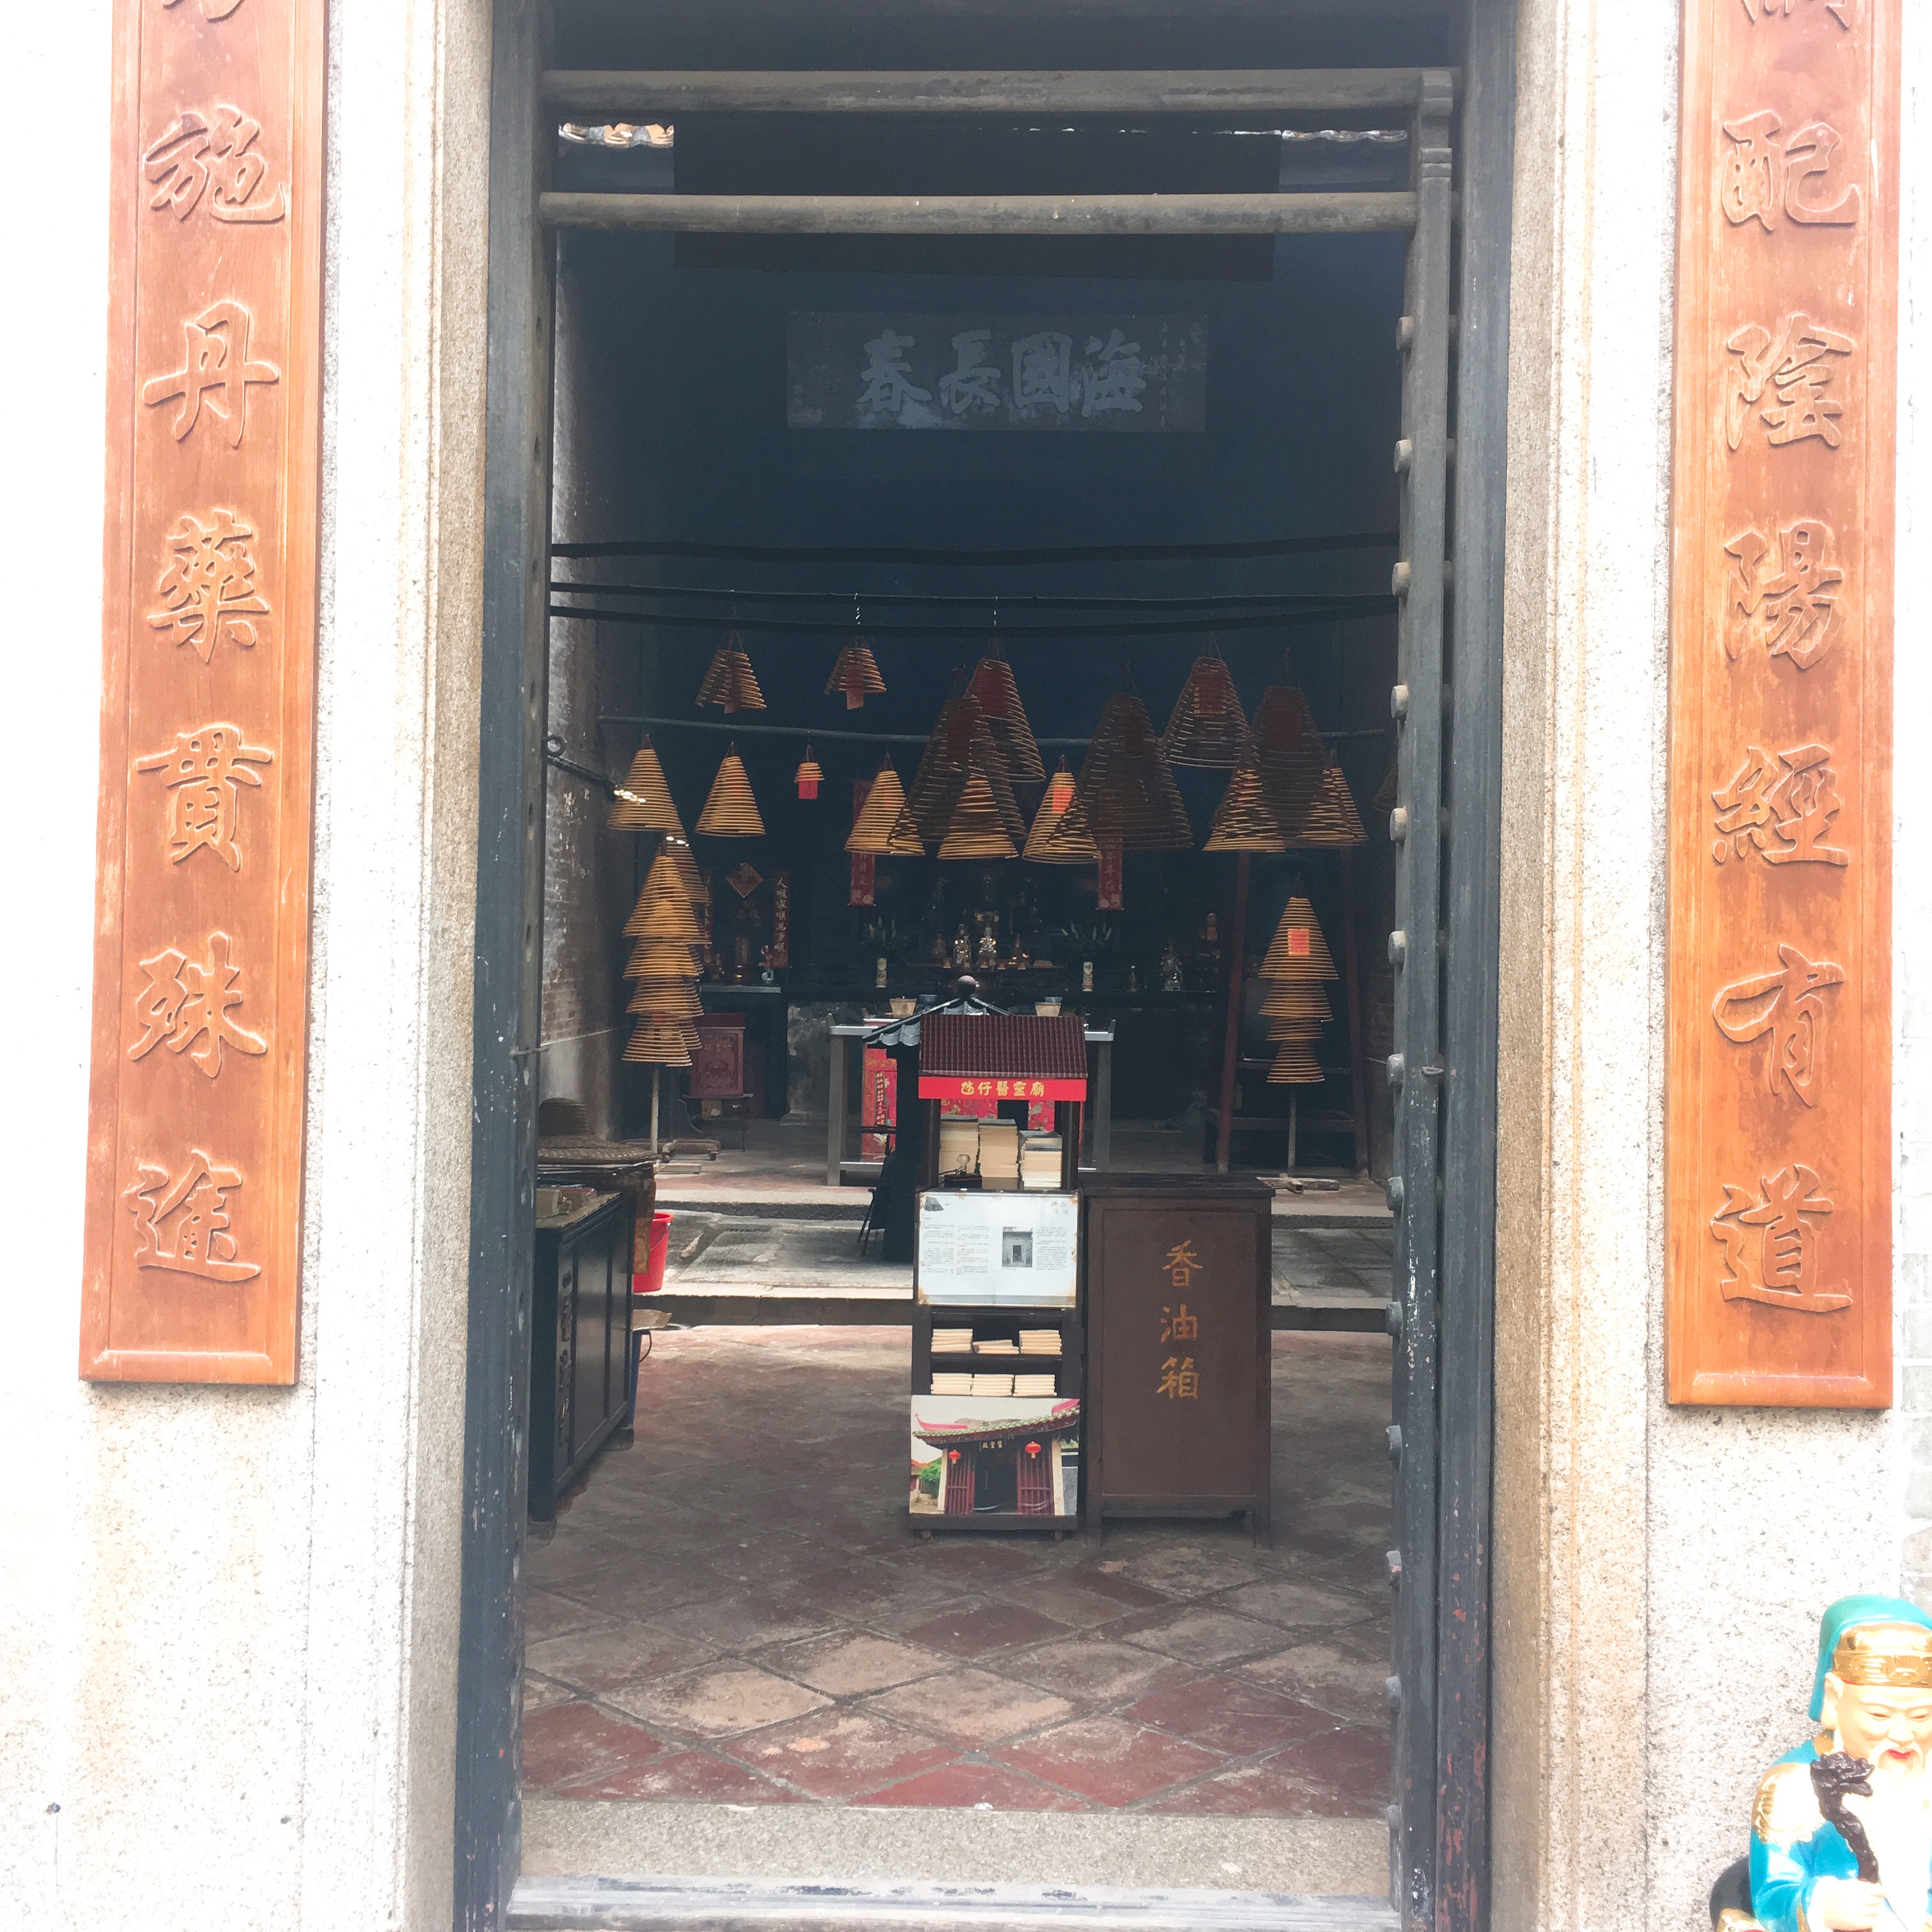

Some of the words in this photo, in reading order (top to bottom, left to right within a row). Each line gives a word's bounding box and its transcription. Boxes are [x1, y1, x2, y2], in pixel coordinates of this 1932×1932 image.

[124, 0, 287, 1283] 施丹藥貫殊途
[1710, 0, 1859, 1313] 配陰陽經有道
[1157, 1240, 1203, 1400] 香油箱
